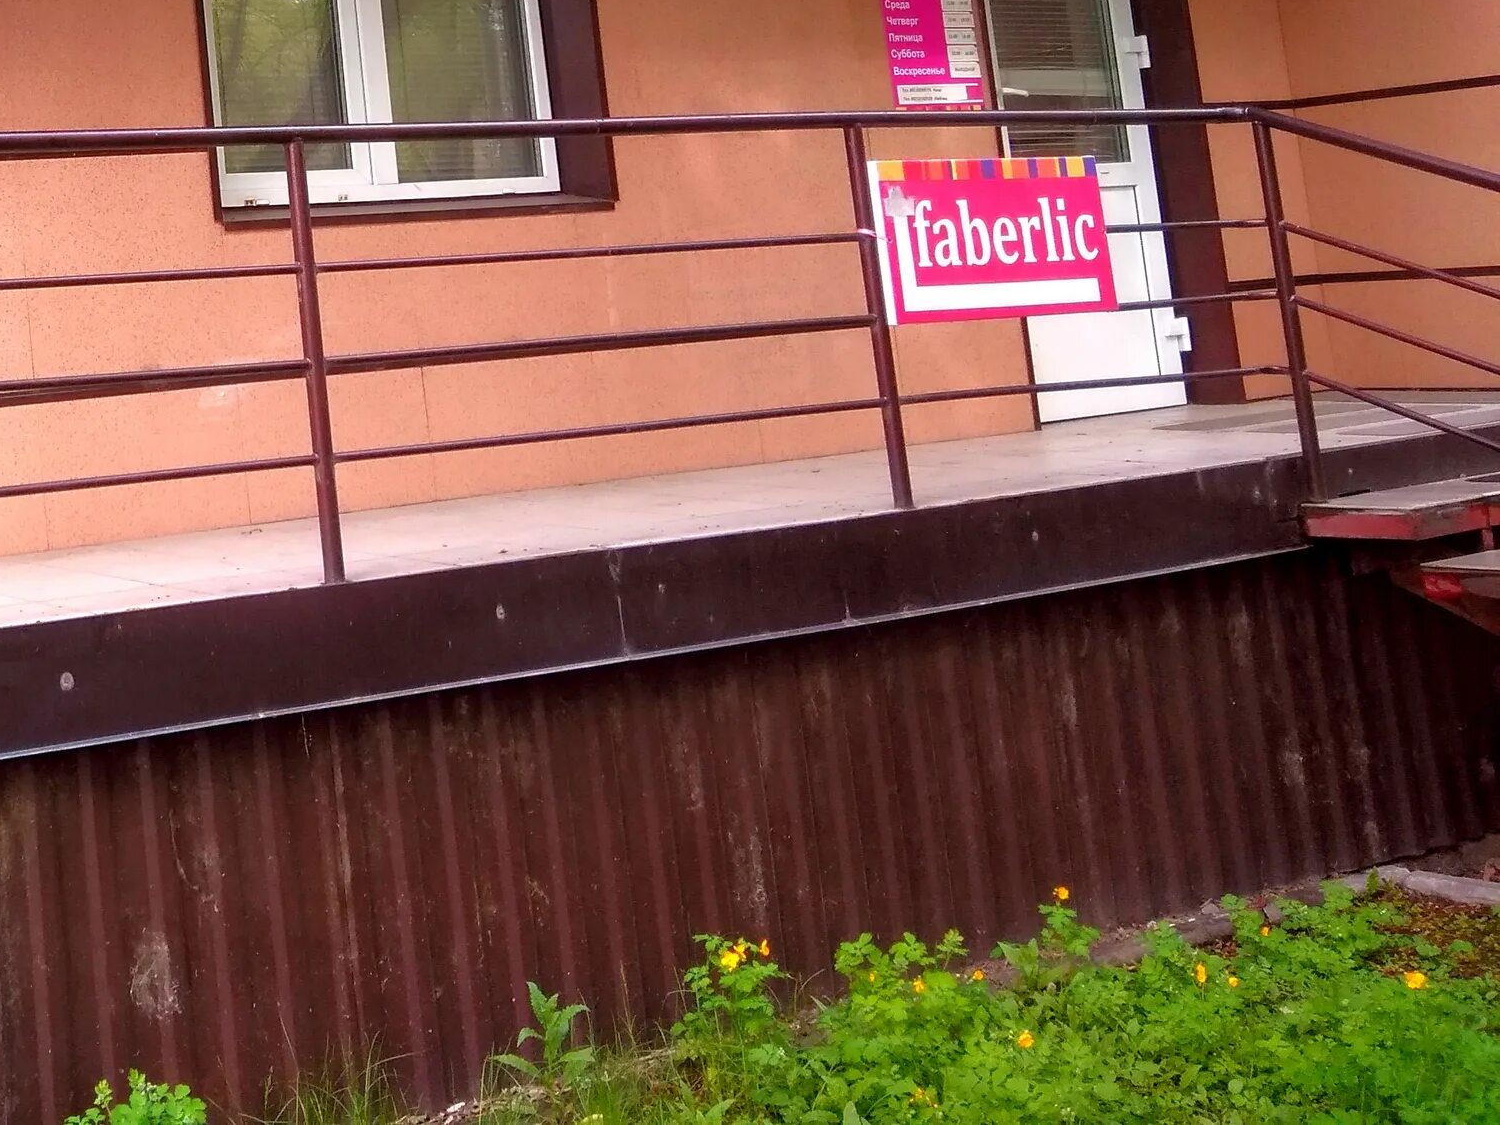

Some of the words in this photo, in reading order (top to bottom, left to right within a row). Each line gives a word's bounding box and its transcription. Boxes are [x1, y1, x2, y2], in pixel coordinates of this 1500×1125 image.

[884, 0, 910, 11] Среда
[886, 16, 919, 28] Четверг
[888, 33, 923, 44] Пятница
[890, 49, 926, 60] Суббота
[893, 66, 946, 78] Воскресенье
[912, 196, 1099, 268] faberlic
